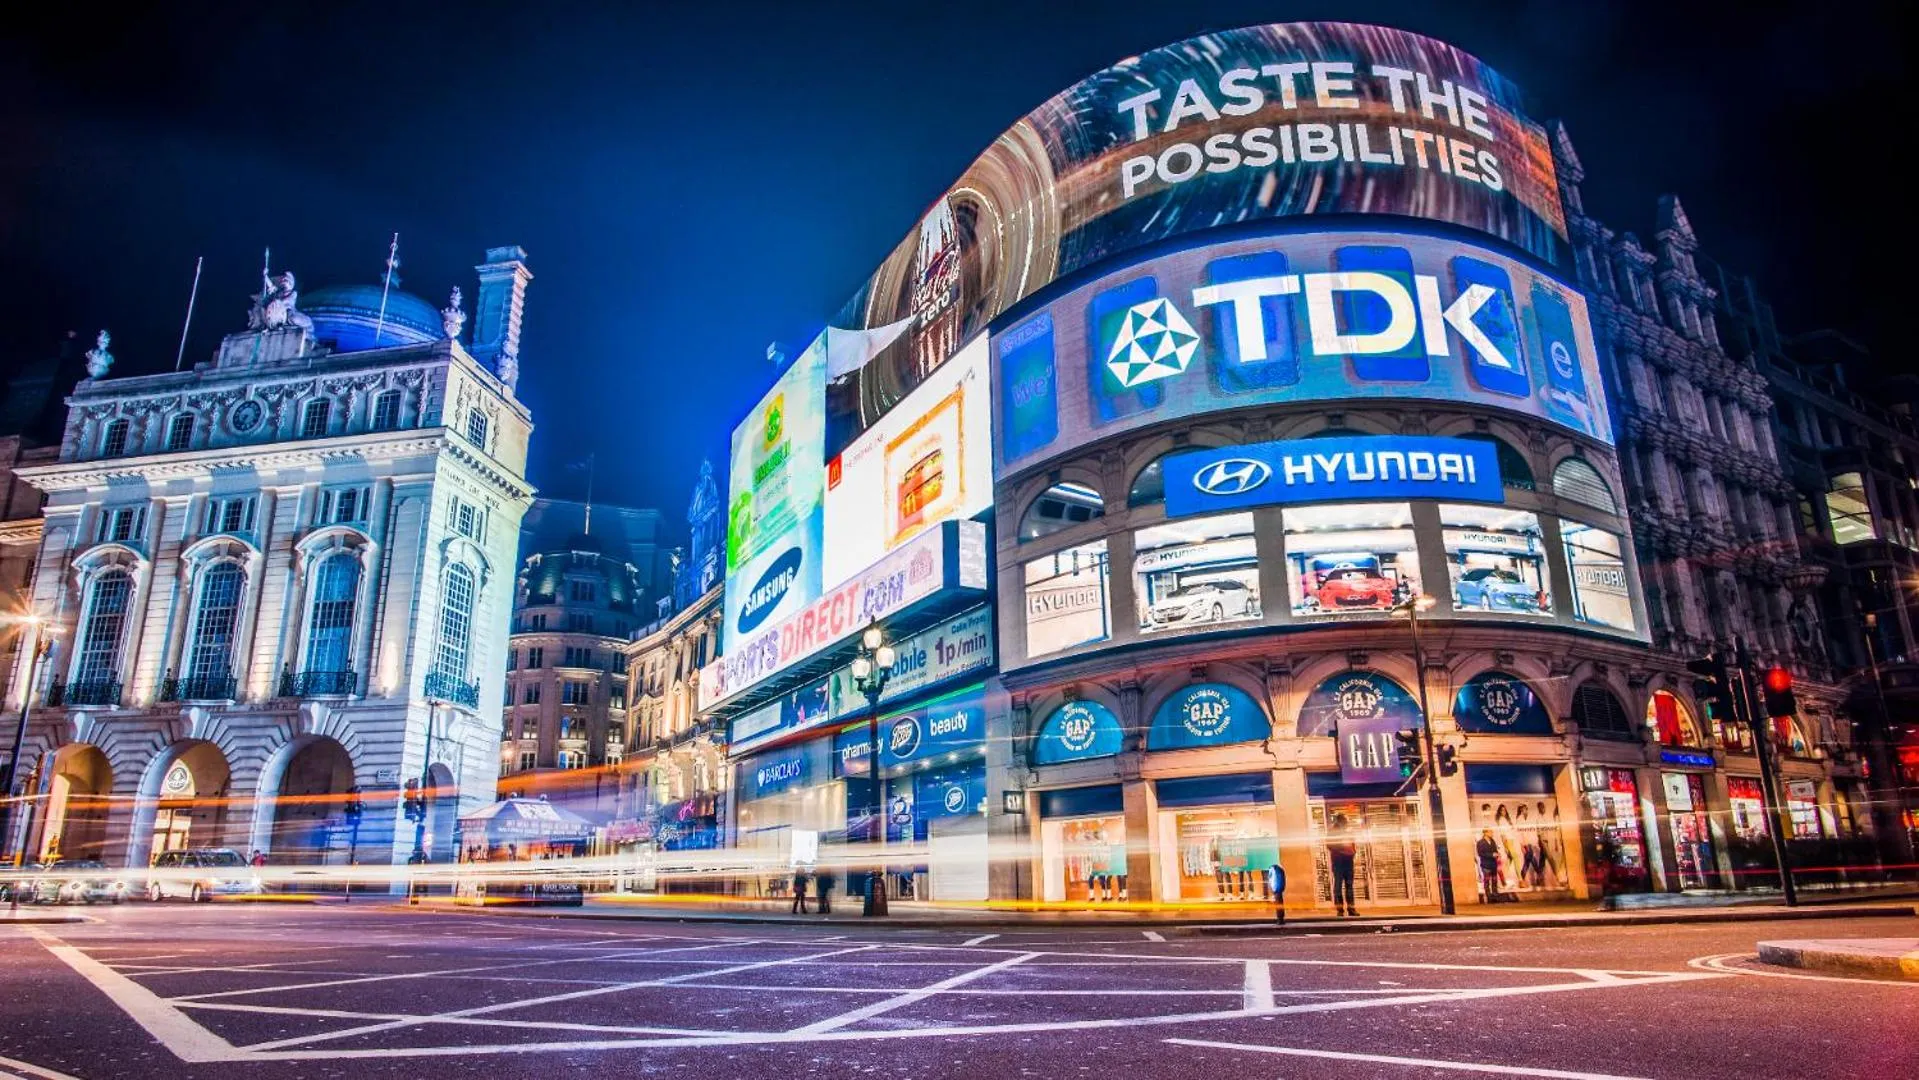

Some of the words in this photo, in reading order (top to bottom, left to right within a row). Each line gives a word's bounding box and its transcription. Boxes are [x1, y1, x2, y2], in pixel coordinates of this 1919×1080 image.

[1118, 62, 1360, 142] TASTE
[1372, 64, 1493, 142] THE
[1121, 123, 1502, 198] POSSIBILITIES
[1192, 271, 1511, 369] TDK
[1282, 451, 1476, 485] HYUNDAI
[746, 566, 794, 606] SAMSUNG
[1190, 702, 1224, 721] GAP
[1342, 691, 1376, 711] GAP
[1487, 690, 1513, 709] GAP
[930, 710, 968, 737] beauty
[1066, 719, 1090, 738] GAP
[1350, 732, 1394, 769] GAP
[765, 759, 801, 779] BARCLAYS
